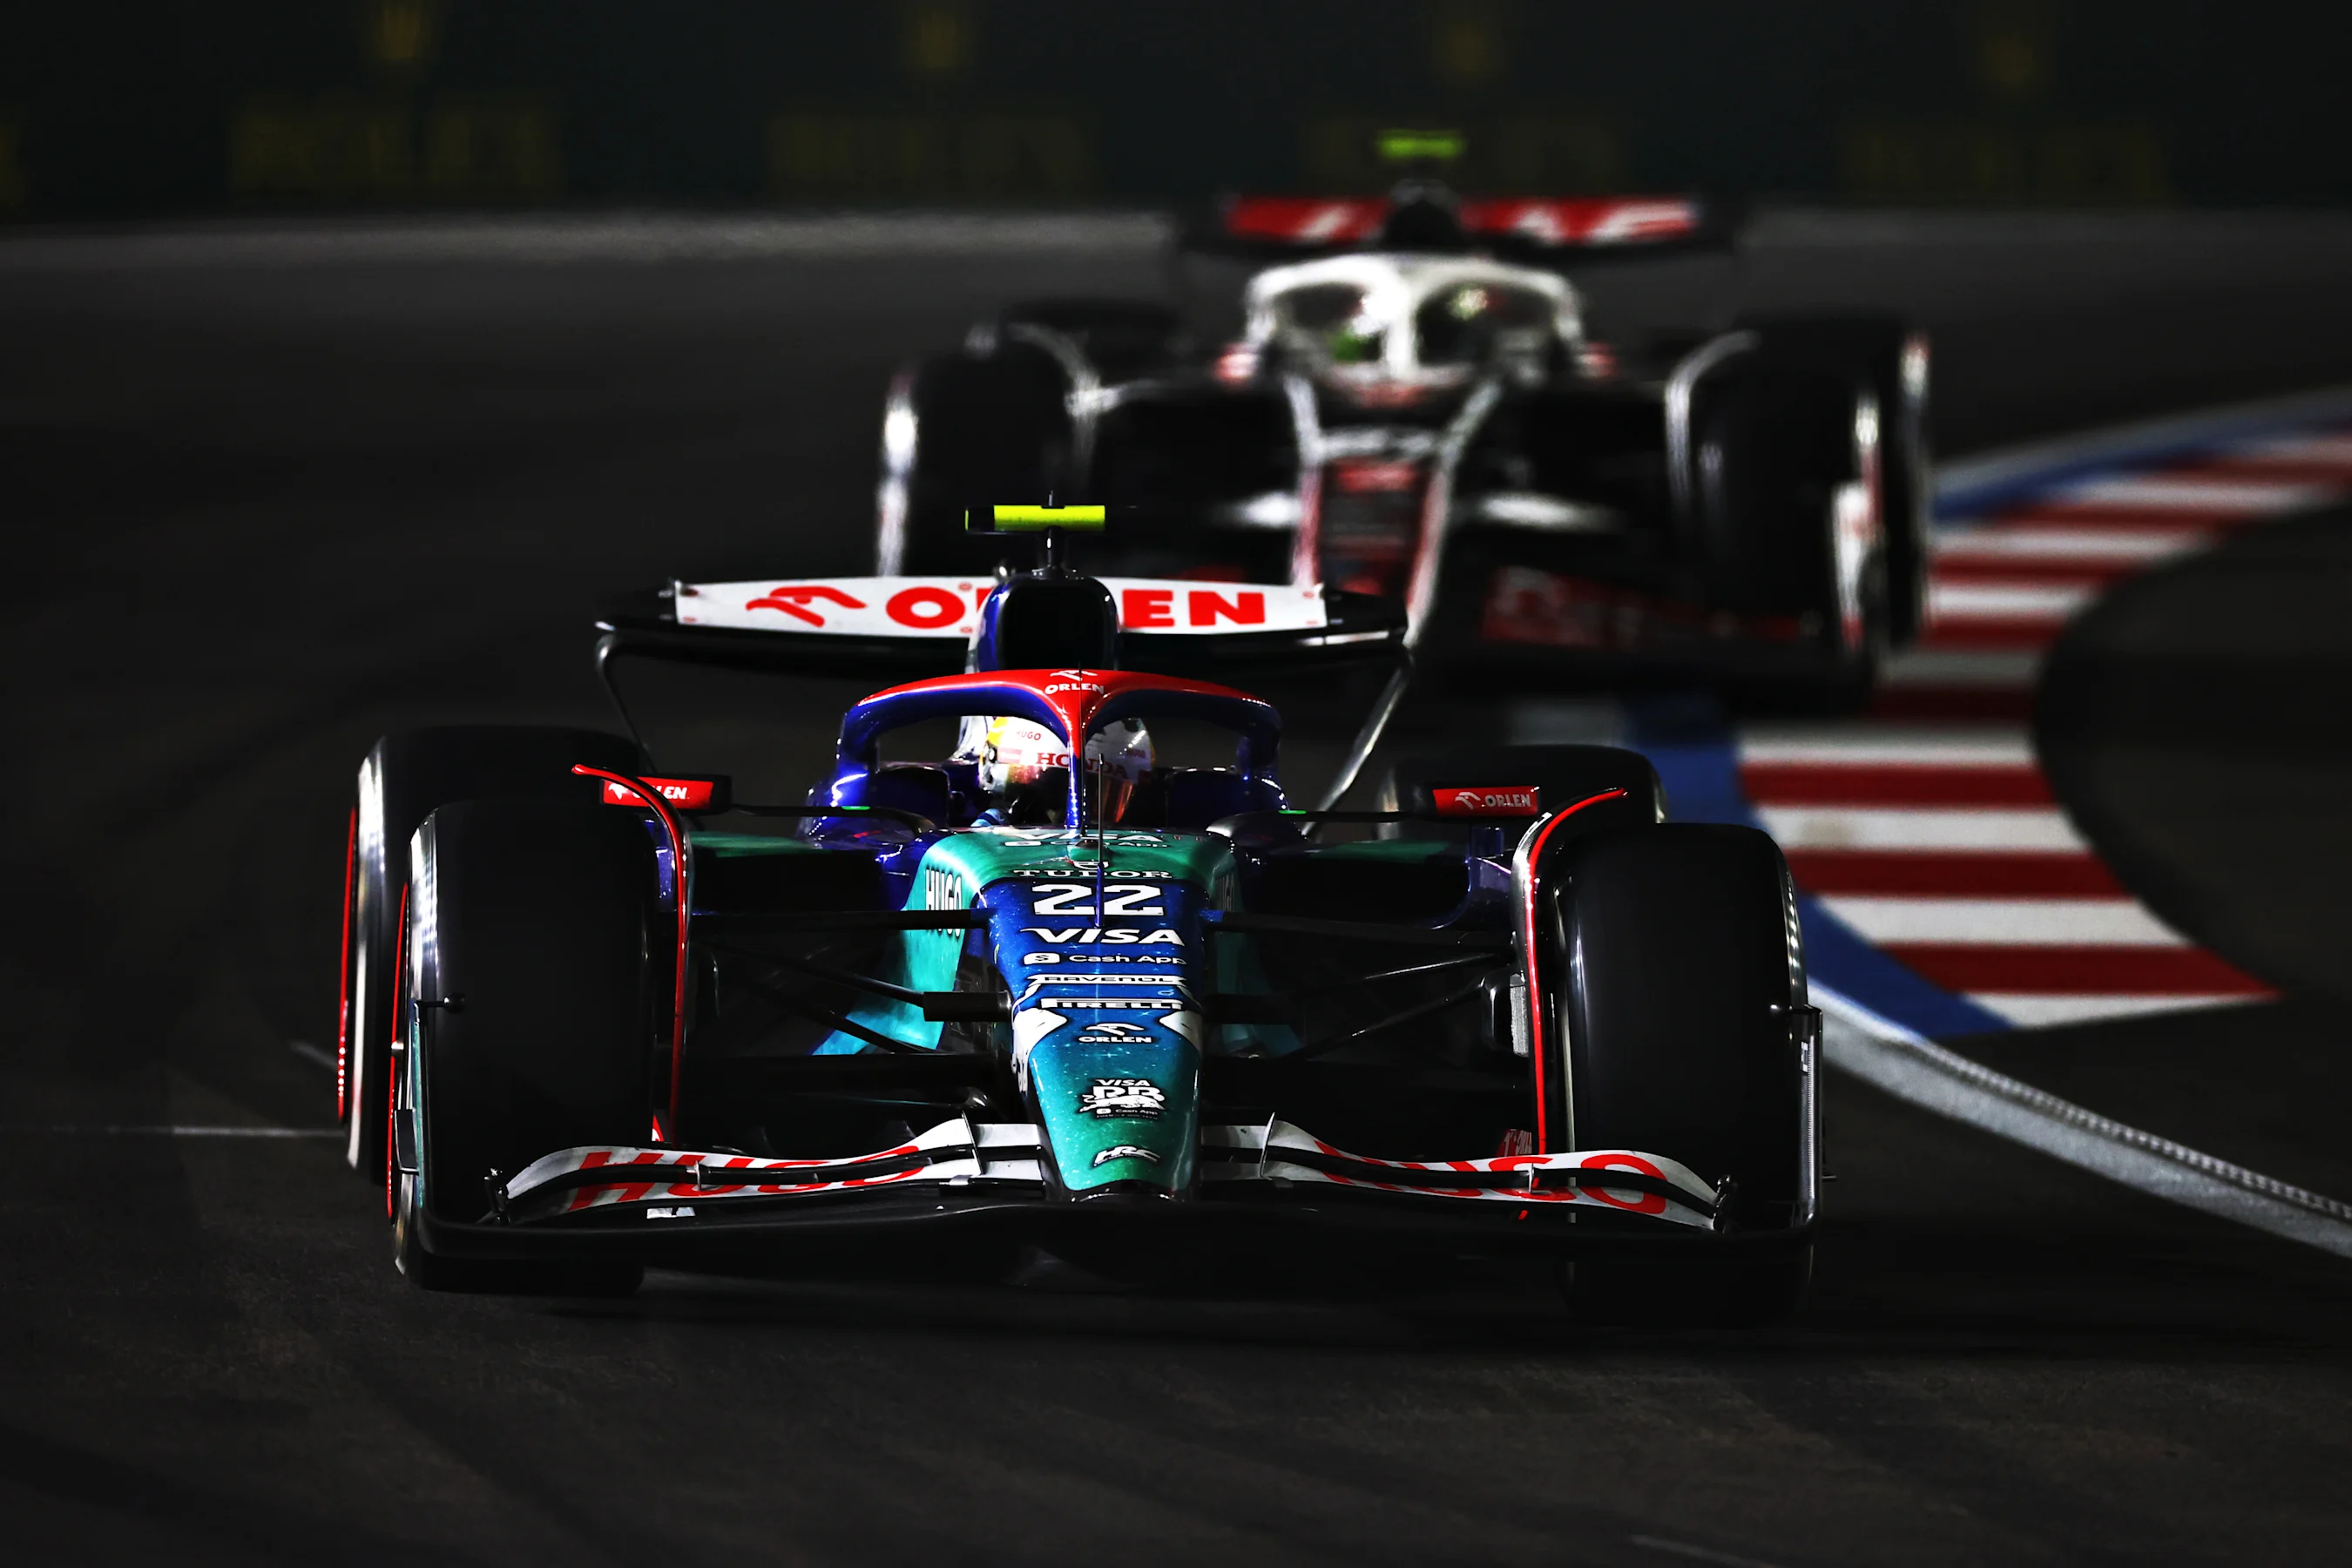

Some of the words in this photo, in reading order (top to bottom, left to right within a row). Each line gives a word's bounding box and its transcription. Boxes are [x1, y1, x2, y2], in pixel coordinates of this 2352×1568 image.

[886, 587, 1266, 628] OEN
[1045, 683, 1104, 694] ORLEN
[1484, 794, 1531, 807] ORLEN
[1014, 869, 1173, 878] TUDOR
[1032, 884, 1164, 916] 22
[1020, 929, 1185, 946] VISA
[1137, 955, 1187, 965] App
[1041, 997, 1184, 1010] PIRELLI
